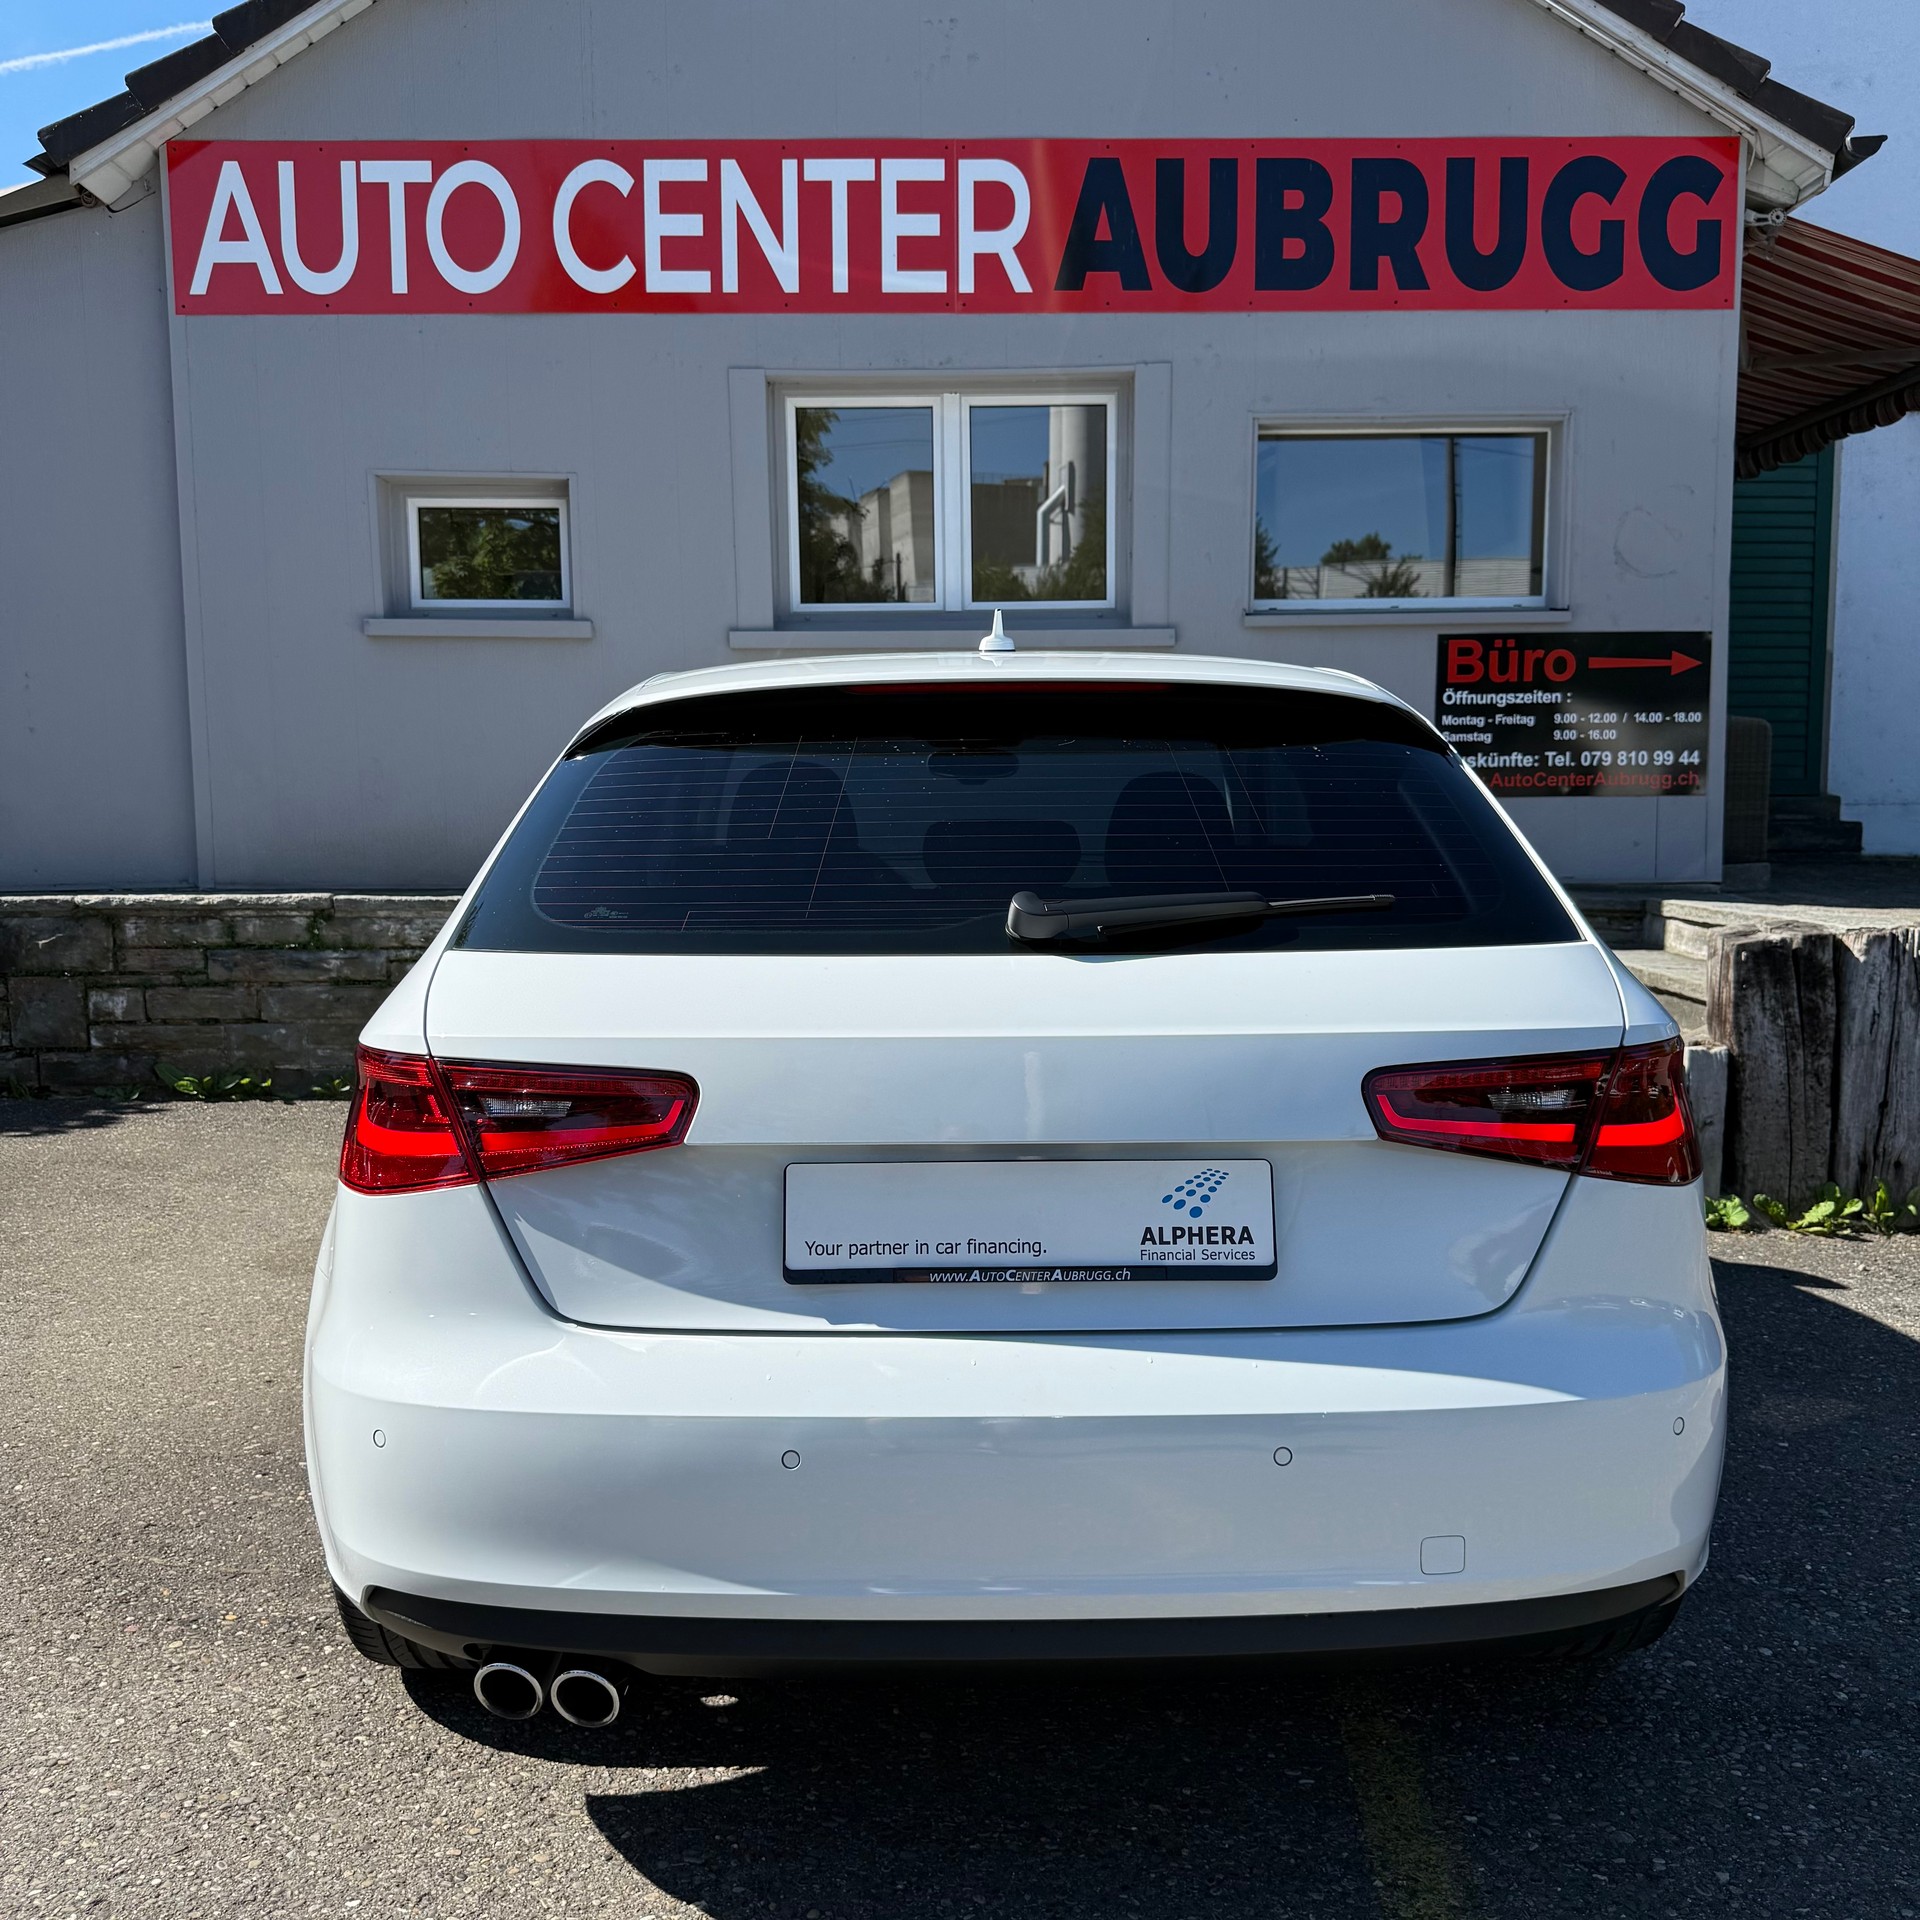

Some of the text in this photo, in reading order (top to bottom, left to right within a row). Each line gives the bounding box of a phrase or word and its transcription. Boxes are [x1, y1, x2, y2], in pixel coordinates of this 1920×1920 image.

[189, 154, 1726, 296] AUTO CENTER AUBRUGG
[1447, 639, 1577, 683] Büro
[1442, 687, 1562, 708] Öffnungszeiten
[1441, 714, 1486, 727] Montag
[1495, 713, 1536, 727] Freitag
[1553, 712, 1577, 724] 9.00
[1588, 712, 1617, 724] 12.00
[1633, 712, 1663, 723] 14.00
[1674, 711, 1702, 723] 18.00
[1442, 731, 1493, 745] Samstag
[1553, 729, 1577, 741] 9.00
[1588, 729, 1616, 741] 16.00
[1461, 749, 1700, 768] skünfte: Tel. 079 810 99 44
[1140, 1226, 1254, 1246] ALPHERA
[804, 1238, 1048, 1259] Your partner in car financing.
[1140, 1248, 1256, 1261] Financial Services
